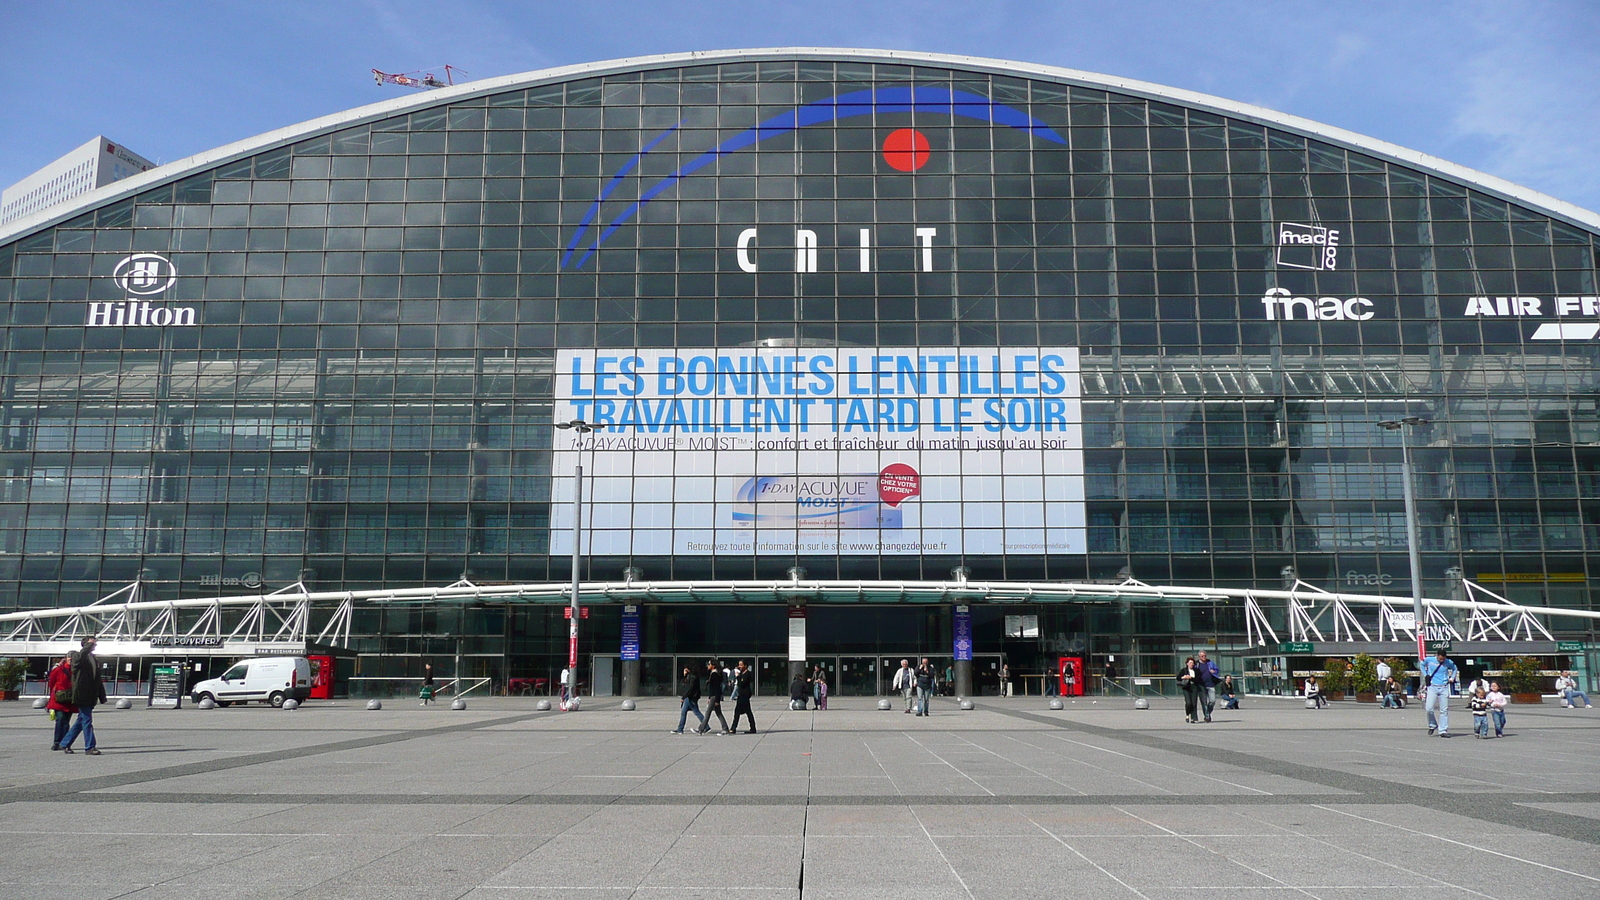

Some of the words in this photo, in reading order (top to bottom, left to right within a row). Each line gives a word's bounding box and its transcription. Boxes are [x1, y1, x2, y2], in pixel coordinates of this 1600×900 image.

[1280, 230, 1325, 244] fnac
[1325, 230, 1339, 271] .com
[1261, 287, 1375, 320] fnac
[1464, 297, 1543, 316] AIR
[86, 298, 196, 327] Hilton
[571, 355, 645, 396] LES
[657, 355, 835, 396] BONNES
[848, 354, 1066, 395] LENTILLES
[569, 400, 816, 434] TRAVAILLENT
[824, 398, 919, 433] TARD
[932, 398, 974, 433] LE
[983, 398, 1067, 433] SOIR
[757, 437, 808, 450] confort
[814, 438, 829, 450] et
[832, 436, 899, 450] fraîcheur
[906, 437, 924, 449] du
[929, 437, 969, 449] matin
[974, 437, 1036, 452] jusqu'au
[1041, 437, 1067, 449] soir
[687, 541, 728, 551] Retrouvez
[730, 542, 750, 551] toute
[807, 543, 820, 551] sur
[821, 541, 829, 551] le
[831, 541, 848, 551] site
[849, 541, 947, 553] www.changezdevue.fr
[200, 574, 239, 586] Hilon
[1345, 570, 1392, 586] fnac
[1391, 613, 1413, 621] TAXIS
[1424, 625, 1451, 641] INA'S
